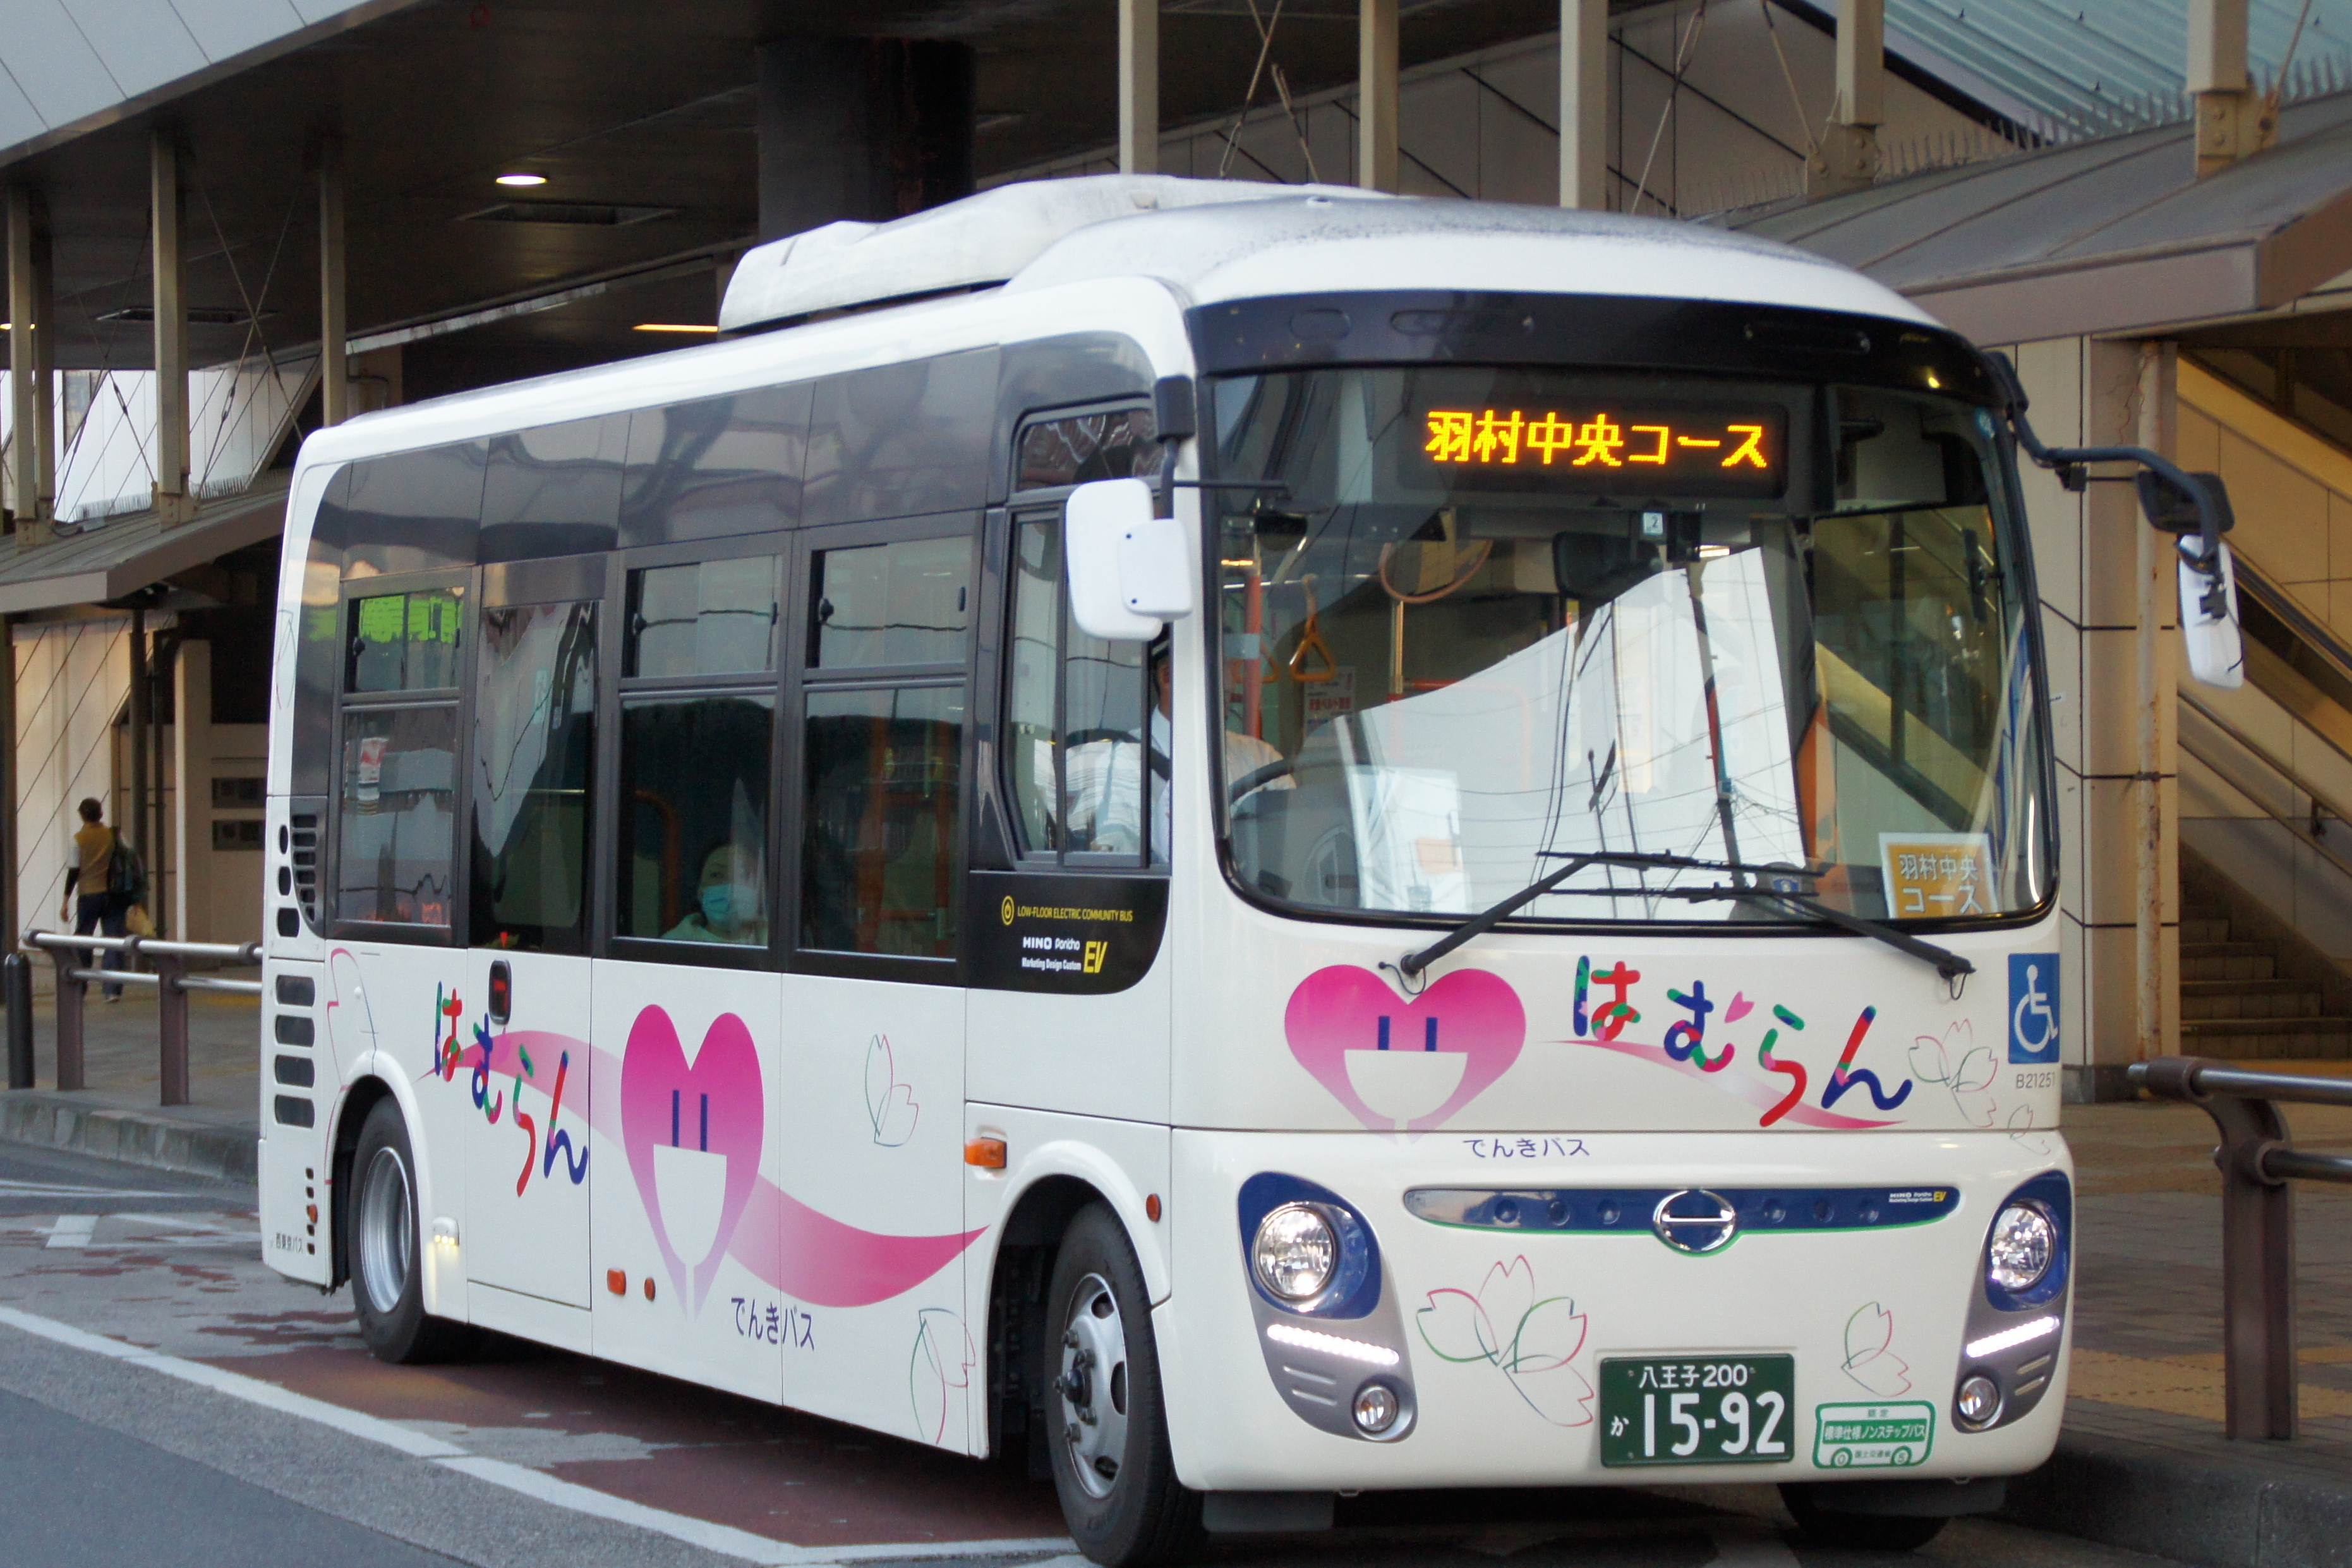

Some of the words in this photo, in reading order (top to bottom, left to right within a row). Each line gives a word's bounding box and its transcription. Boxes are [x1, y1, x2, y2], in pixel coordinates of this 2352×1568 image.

[1425, 410, 1766, 468] 羽村中央コース
[1899, 853, 1979, 881] 羽村中央
[1018, 905, 1052, 919] LOW-FLOOR
[1053, 907, 1081, 920] ELECTRIC
[1082, 908, 1118, 921] COMMUNITY
[1119, 910, 1133, 922] BUS
[1903, 885, 1984, 914] コース
[1022, 936, 1052, 950] HINO
[1083, 941, 1108, 974] EV
[1022, 957, 1045, 971] Marketing
[1046, 958, 1062, 972] Design
[1574, 955, 1912, 1127] はむらん
[434, 980, 589, 1198] はむらん
[1462, 1138, 1589, 1158] でんきバス
[731, 1297, 815, 1352] でんきバス
[1610, 1415, 1629, 1437] か
[1644, 1390, 1785, 1457] 15-92
